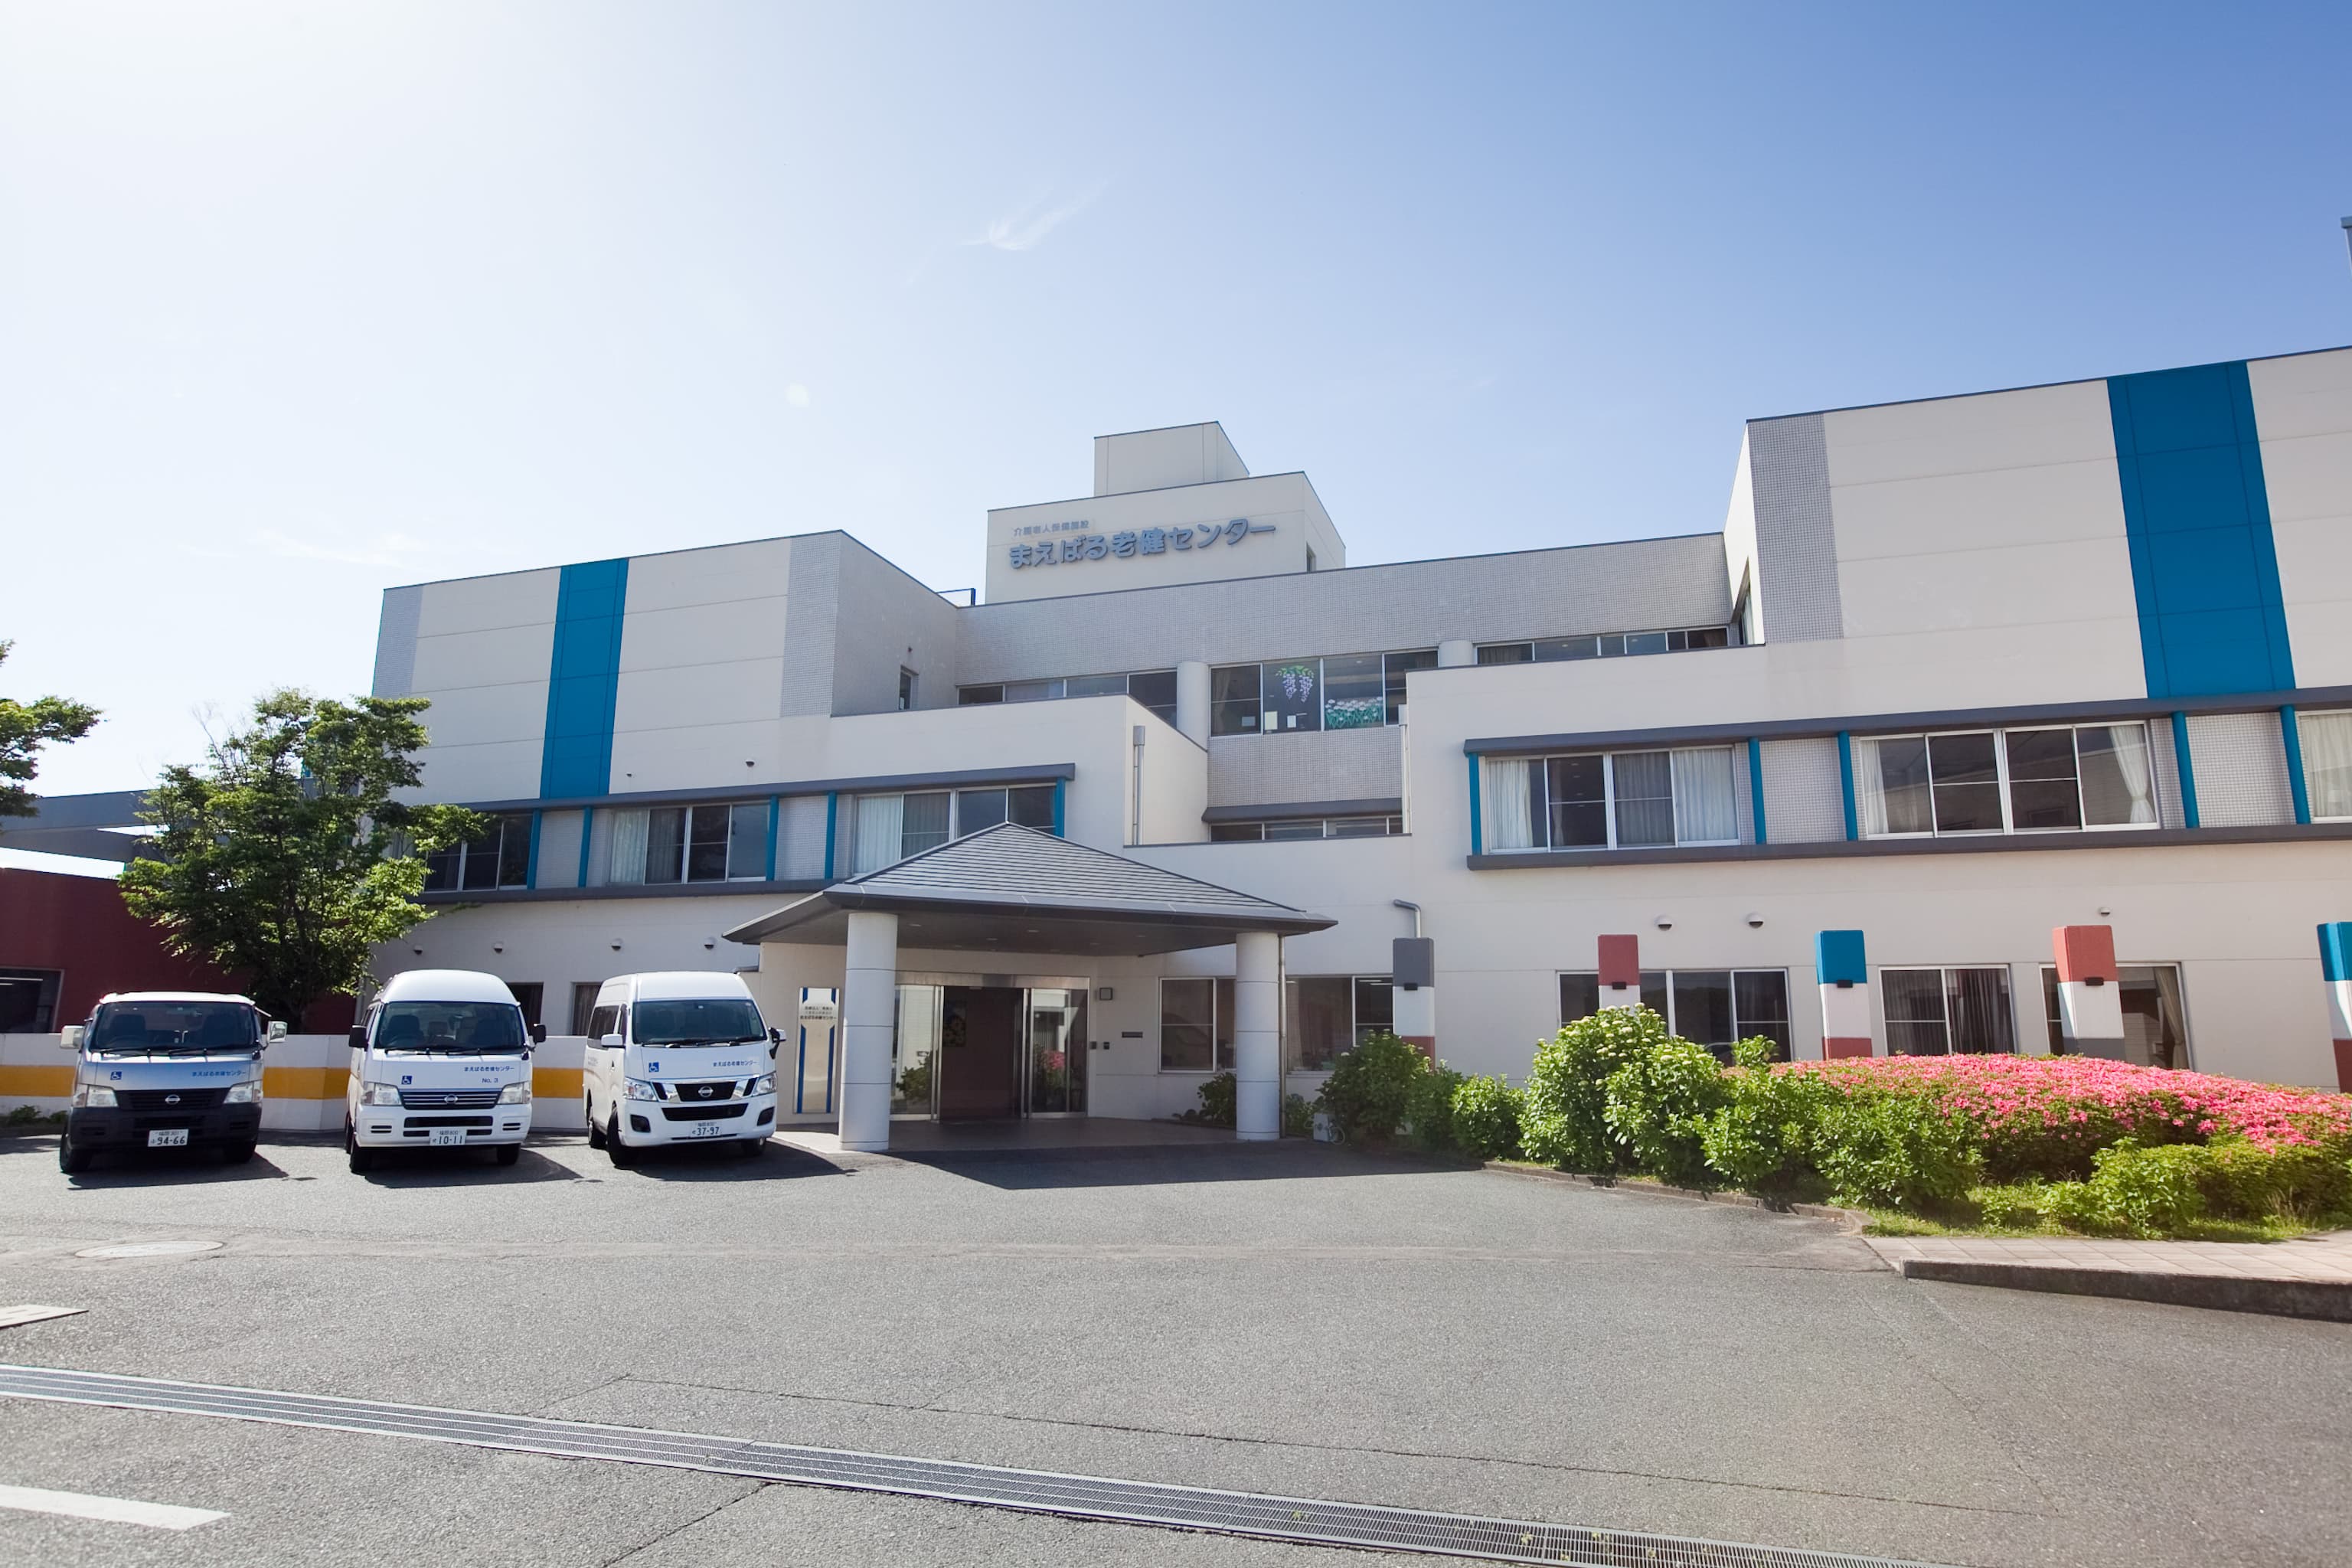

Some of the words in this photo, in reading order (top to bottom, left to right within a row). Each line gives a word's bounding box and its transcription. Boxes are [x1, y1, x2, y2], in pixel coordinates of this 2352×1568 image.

[1009, 518, 1276, 570] まえばる老健センター
